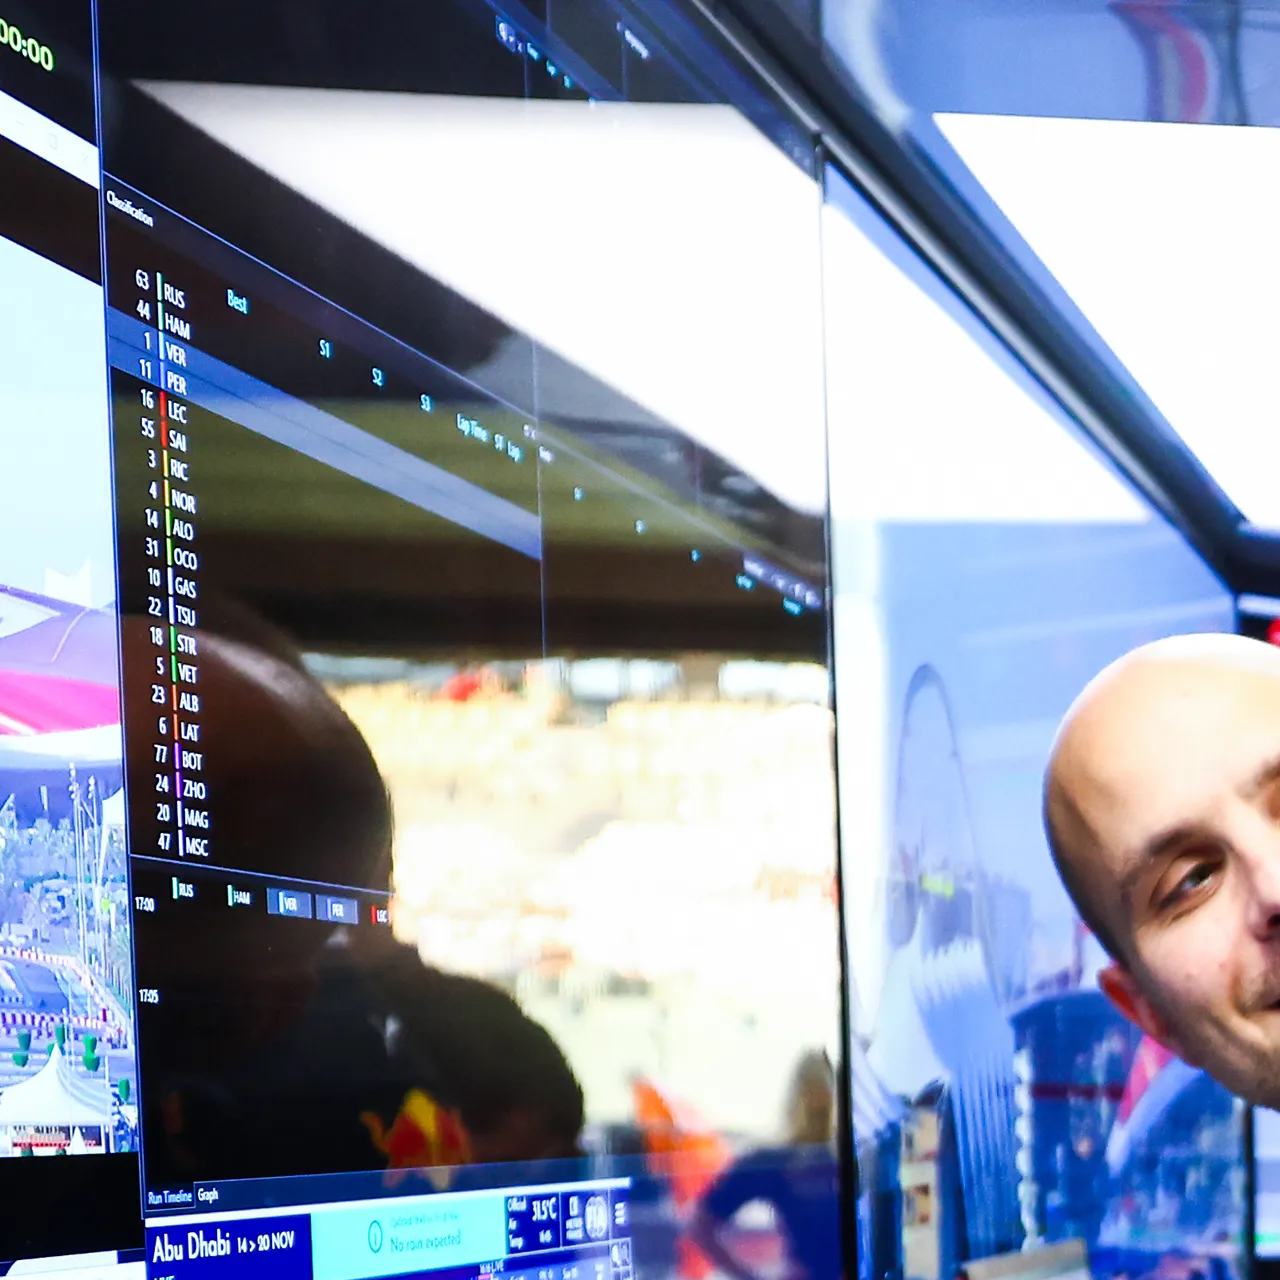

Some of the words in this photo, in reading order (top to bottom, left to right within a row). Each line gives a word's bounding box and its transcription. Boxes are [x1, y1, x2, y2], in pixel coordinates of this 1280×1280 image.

[107, 190, 153, 227] Classification
[135, 269, 149, 290] 63
[164, 283, 185, 309] RUS
[136, 299, 150, 320] 44
[165, 312, 190, 340] HAM
[144, 332, 150, 349] 1
[166, 341, 187, 367] VER
[227, 288, 248, 315] Best
[319, 338, 330, 359] S1
[371, 367, 383, 387] S2
[420, 394, 431, 412] S3
[139, 358, 152, 379] 11
[167, 370, 187, 396] PER
[140, 389, 154, 410] 16
[168, 400, 187, 424] LEC
[141, 417, 155, 439] 55
[169, 429, 187, 452] SAI
[148, 449, 156, 468] 3
[170, 458, 188, 481] RIC
[149, 481, 157, 499] 4
[171, 488, 196, 514] NOR
[145, 508, 159, 528] 14
[173, 518, 194, 541] ALO
[145, 537, 159, 557] 31
[173, 548, 197, 570] OCO
[148, 568, 161, 587] 10
[175, 577, 196, 599] GAS
[148, 596, 162, 616] 22
[175, 605, 196, 627] TSU
[149, 626, 163, 646] 18
[176, 634, 197, 656] STR
[156, 656, 164, 675] 5
[177, 662, 197, 684] VET
[151, 684, 165, 704] 23
[179, 692, 199, 712] ALB
[158, 716, 167, 736] 6
[180, 721, 200, 742] LAT
[153, 744, 167, 764] 77
[182, 750, 202, 771] BOT
[155, 773, 169, 793] 24
[183, 778, 206, 800] ZHO
[156, 803, 170, 822] 20
[184, 807, 209, 829] MAG
[157, 832, 171, 851] 47
[185, 836, 209, 857] MSC
[134, 896, 155, 913] 17:00
[138, 988, 159, 1004] 17:05
[148, 1192, 162, 1205] Run
[163, 1190, 192, 1203] Timeline
[197, 1188, 219, 1204] Graph
[152, 1232, 184, 1263] Abu
[187, 1230, 231, 1260] Dhabi
[237, 1237, 247, 1254] 14
[257, 1235, 270, 1252] 20
[271, 1230, 295, 1249] NOV
